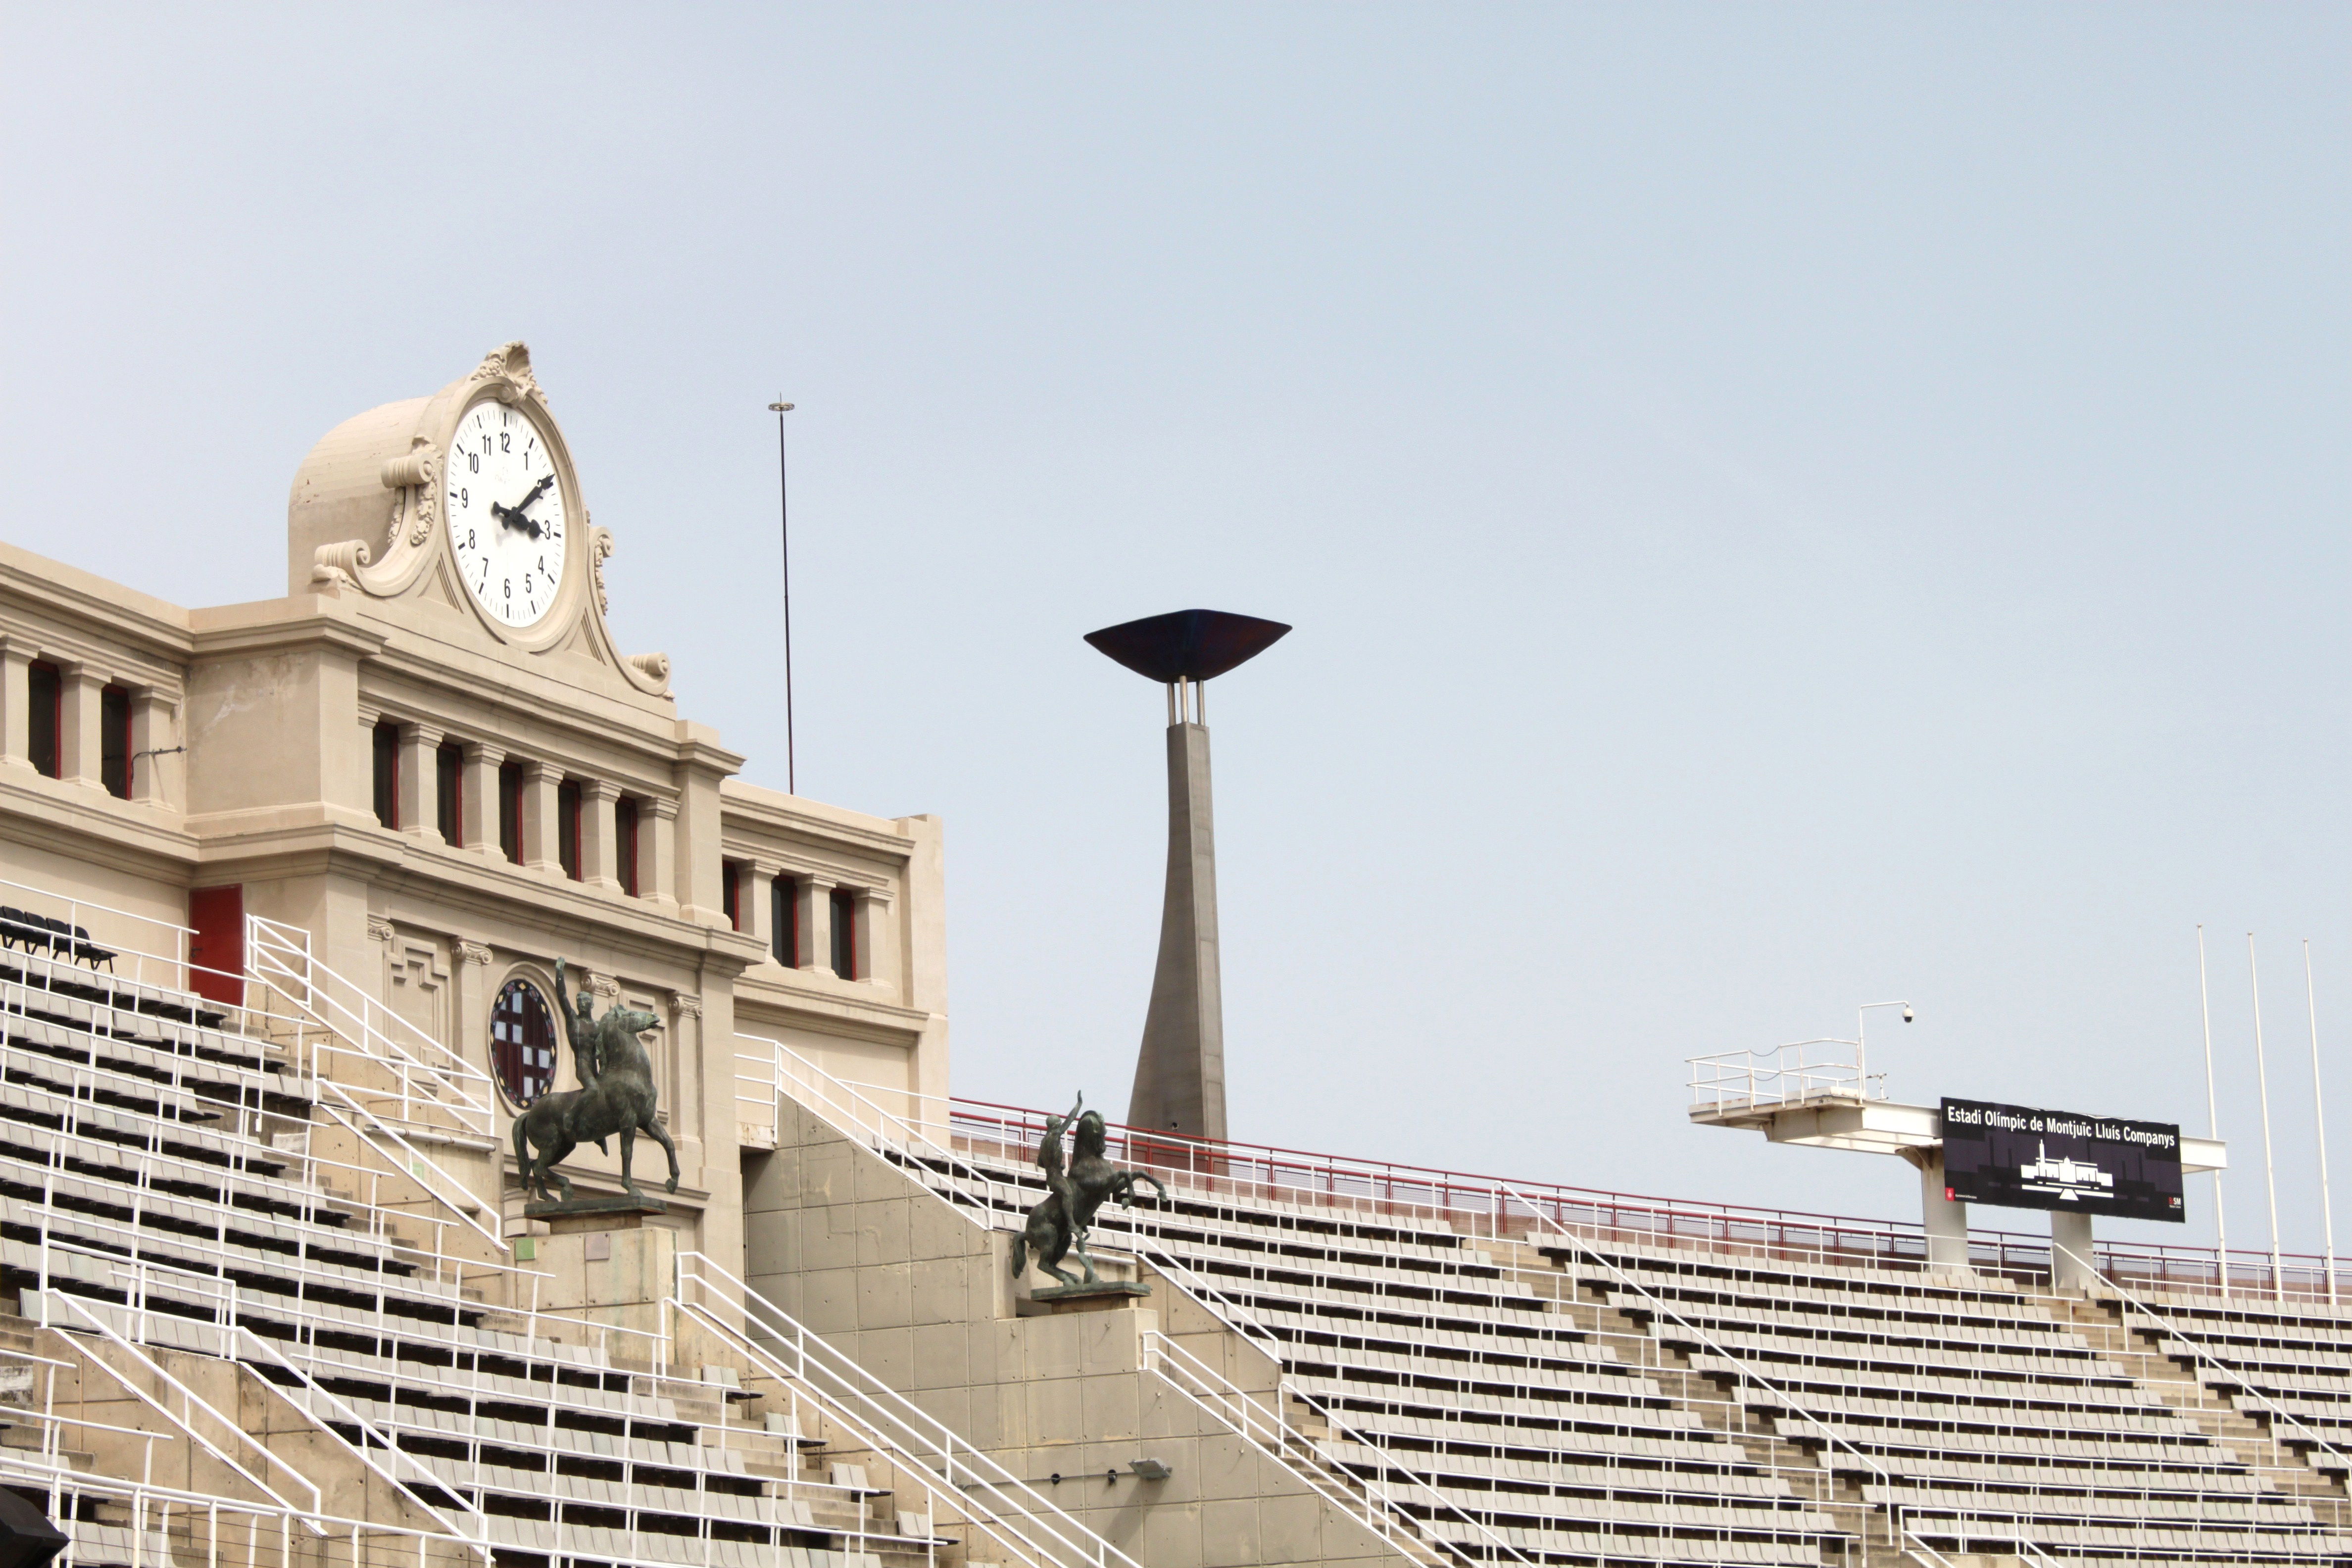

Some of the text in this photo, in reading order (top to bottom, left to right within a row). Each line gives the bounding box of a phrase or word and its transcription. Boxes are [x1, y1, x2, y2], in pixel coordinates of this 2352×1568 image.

[482, 435, 491, 456] 11
[499, 432, 510, 453] 12
[468, 452, 479, 474] 10
[523, 451, 528, 471] 1
[461, 488, 468, 508] 9
[469, 529, 476, 549] 8
[544, 520, 550, 540] 3
[482, 557, 489, 577] 7
[538, 555, 544, 575] 4
[504, 578, 511, 599] 6
[526, 573, 532, 593] 5
[1948, 1106, 2175, 1149] Estadi Olímpic de Montjuïc Lluís Companys
